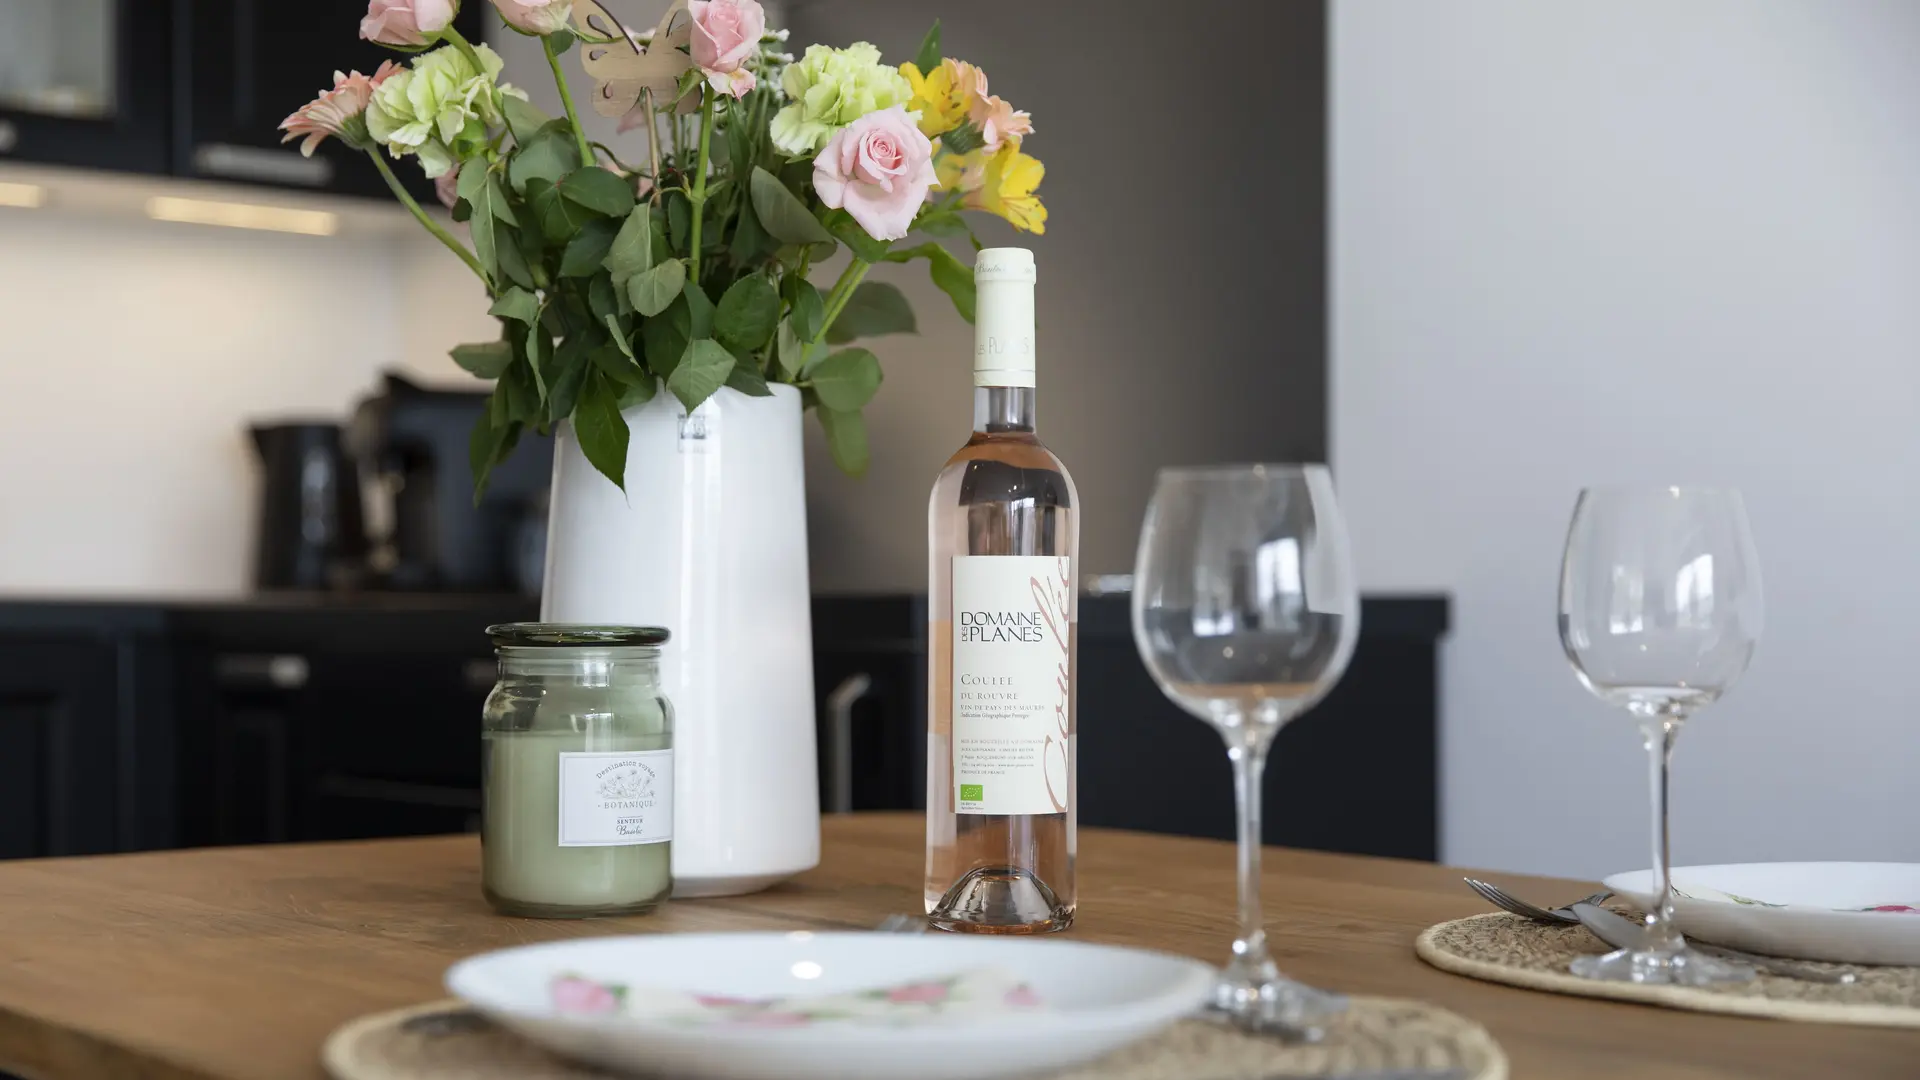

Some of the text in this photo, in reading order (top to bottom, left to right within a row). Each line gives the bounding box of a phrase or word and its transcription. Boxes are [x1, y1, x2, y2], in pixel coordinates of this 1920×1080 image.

[961, 611, 1042, 626] DOMAINE
[969, 626, 1043, 642] PLANES
[961, 692, 1019, 700] DU ROUVRE
[596, 760, 656, 779] Destination voyage
[604, 801, 653, 809] BOTANIQUE
